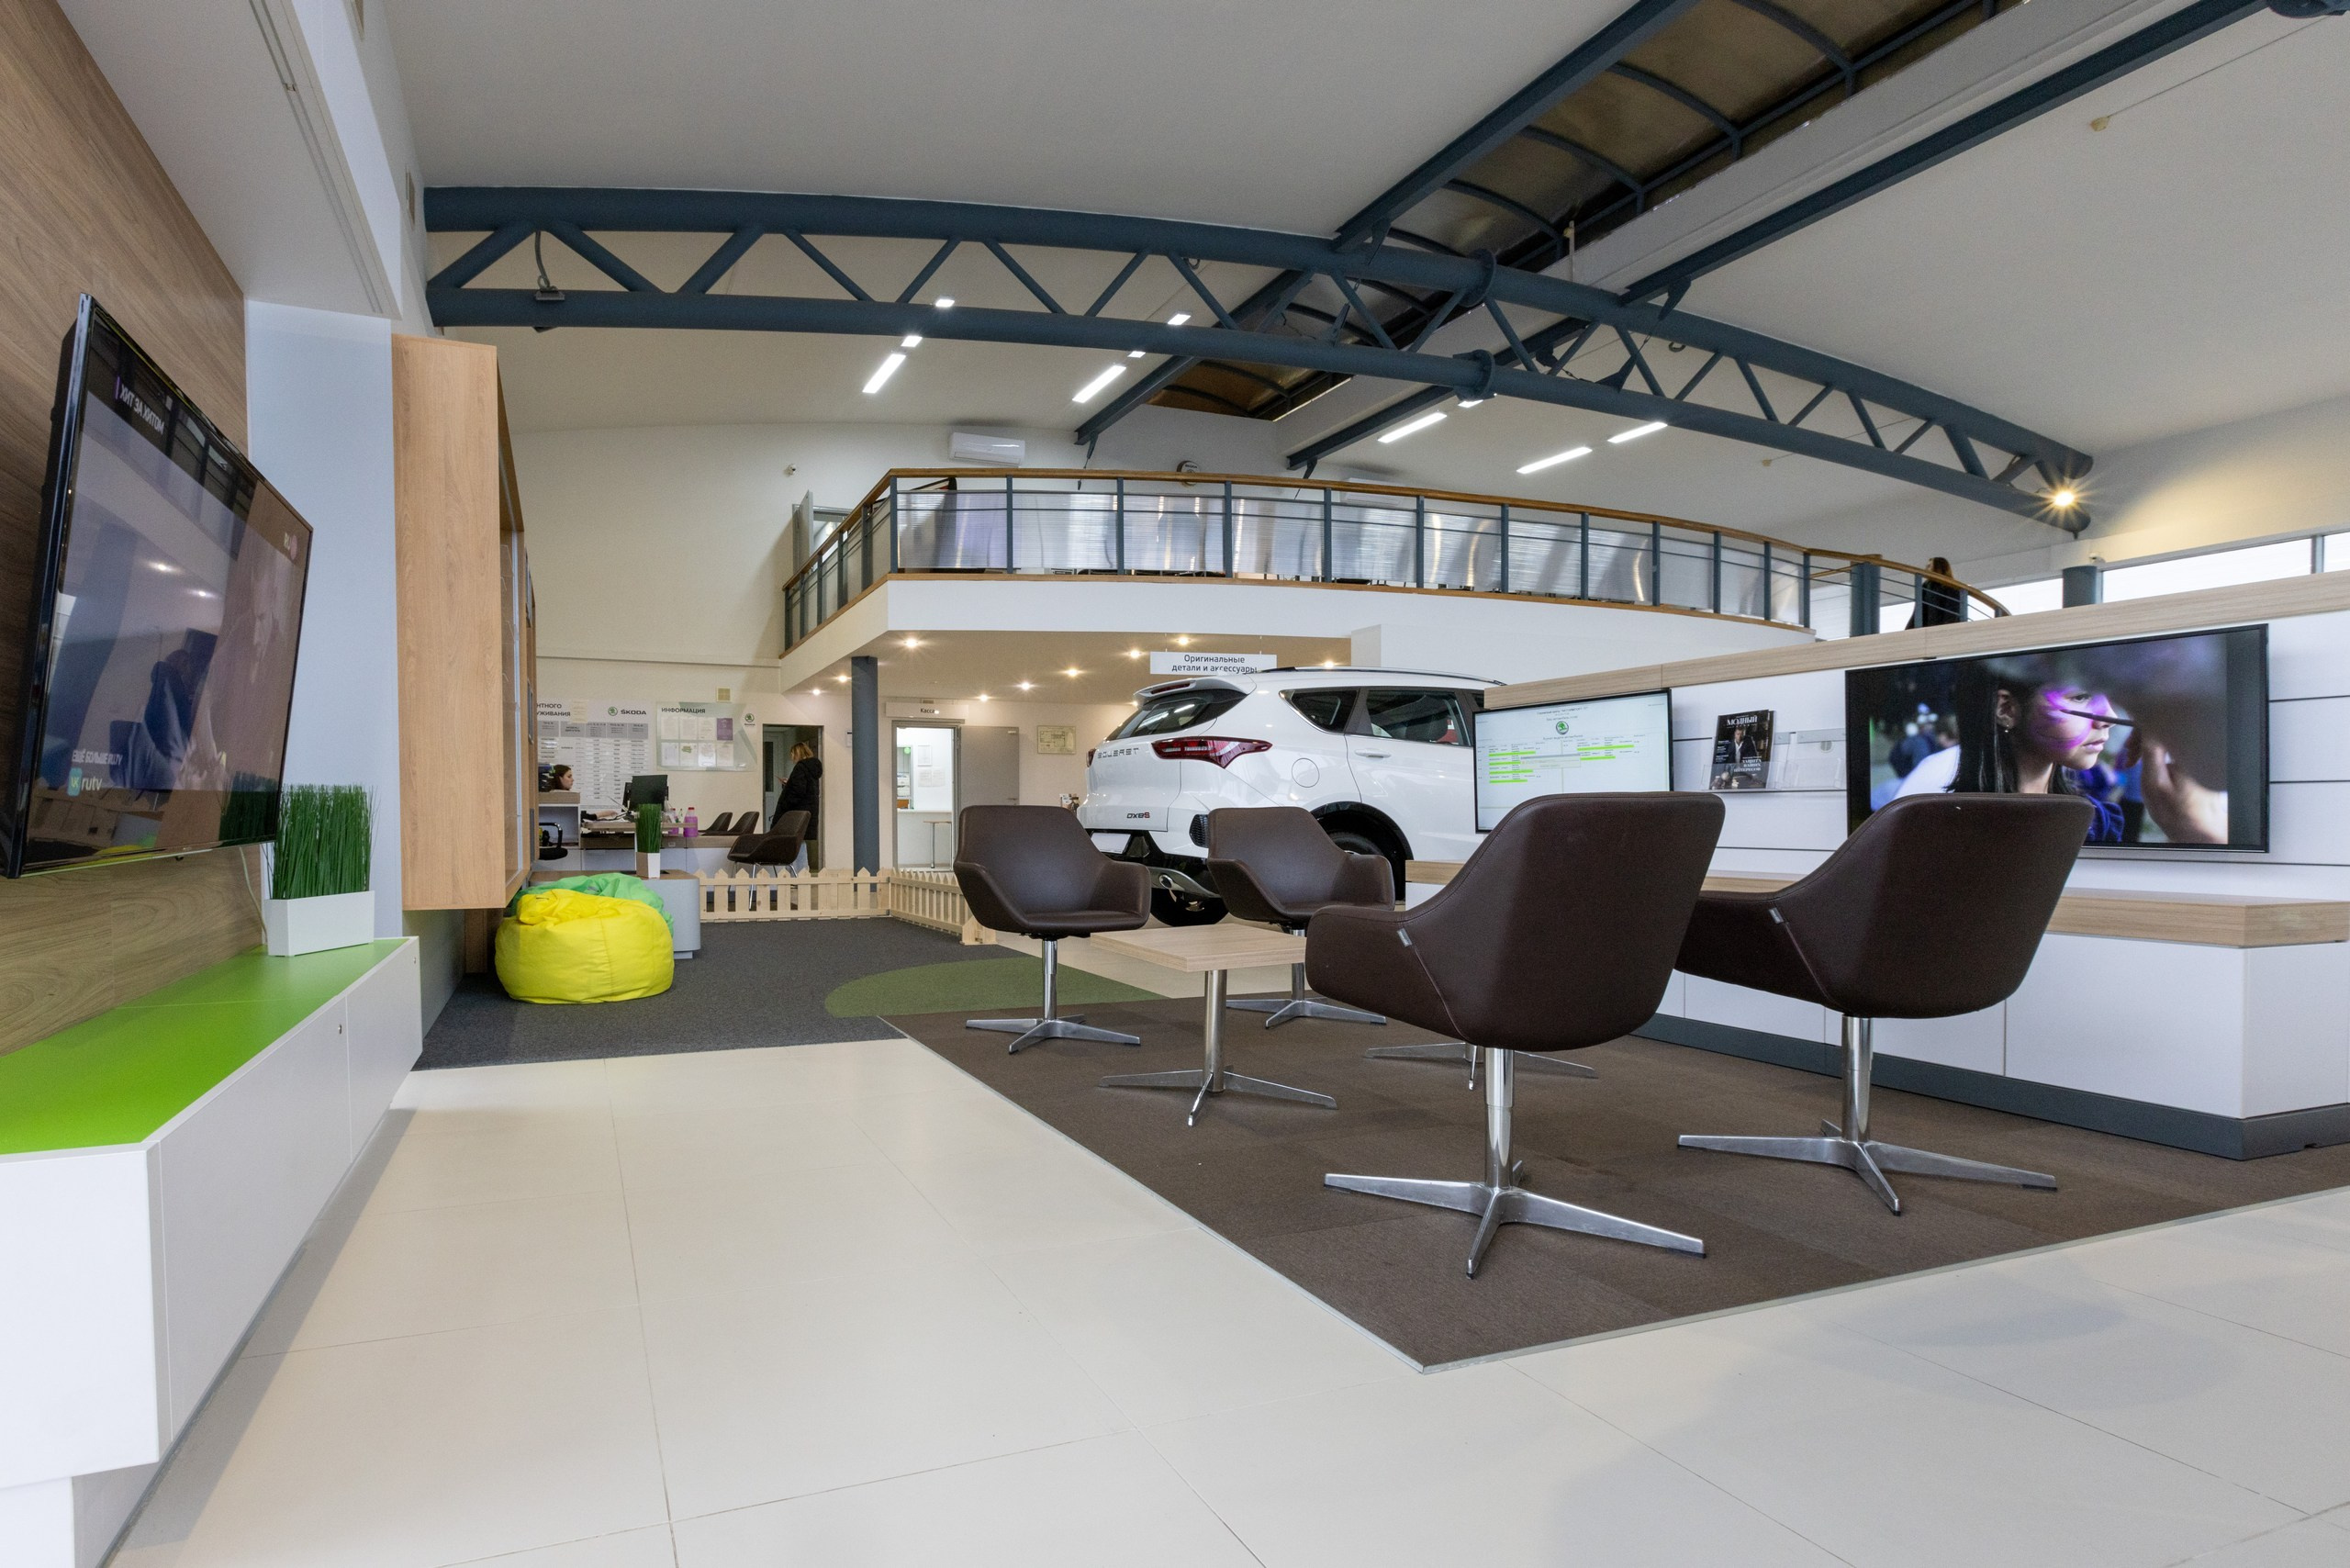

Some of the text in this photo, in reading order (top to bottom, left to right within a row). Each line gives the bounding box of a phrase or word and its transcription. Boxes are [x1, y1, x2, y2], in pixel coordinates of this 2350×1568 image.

[120, 384, 164, 434] ХИТ ЗА ХИТОМ
[1184, 655, 1245, 664] Оригинальные
[82, 776, 103, 790] rutv
